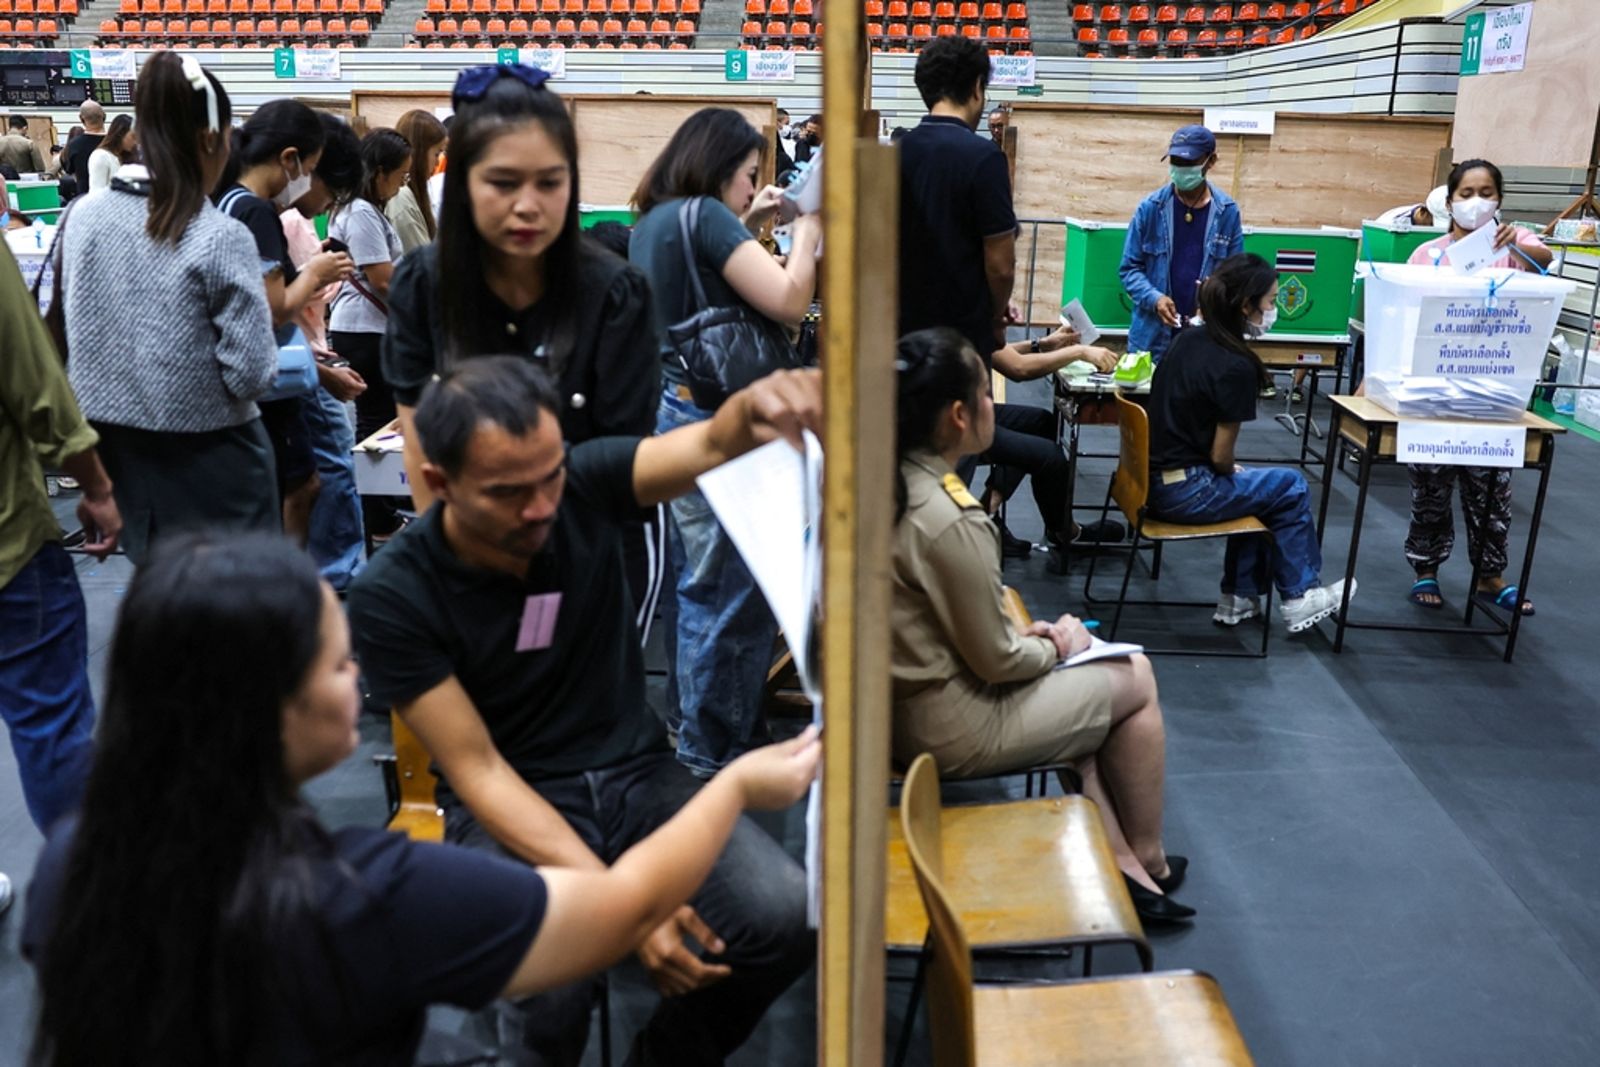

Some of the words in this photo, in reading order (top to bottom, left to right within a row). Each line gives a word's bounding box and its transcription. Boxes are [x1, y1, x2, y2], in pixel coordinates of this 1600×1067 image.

[1466, 36, 1479, 61] 11
[76, 60, 87, 73] 6
[281, 59, 290, 71] 7
[731, 60, 742, 73] 9
[1446, 300, 1519, 318] หีบบัตรเลอกตั้ง
[1440, 341, 1511, 358] หีบบัตรเลือกตั้ง
[1436, 361, 1515, 374] ส.ส.แบบแบ่งเขต
[1407, 438, 1515, 458] ควบคุมหีบบัตรเลือกตั้ง
